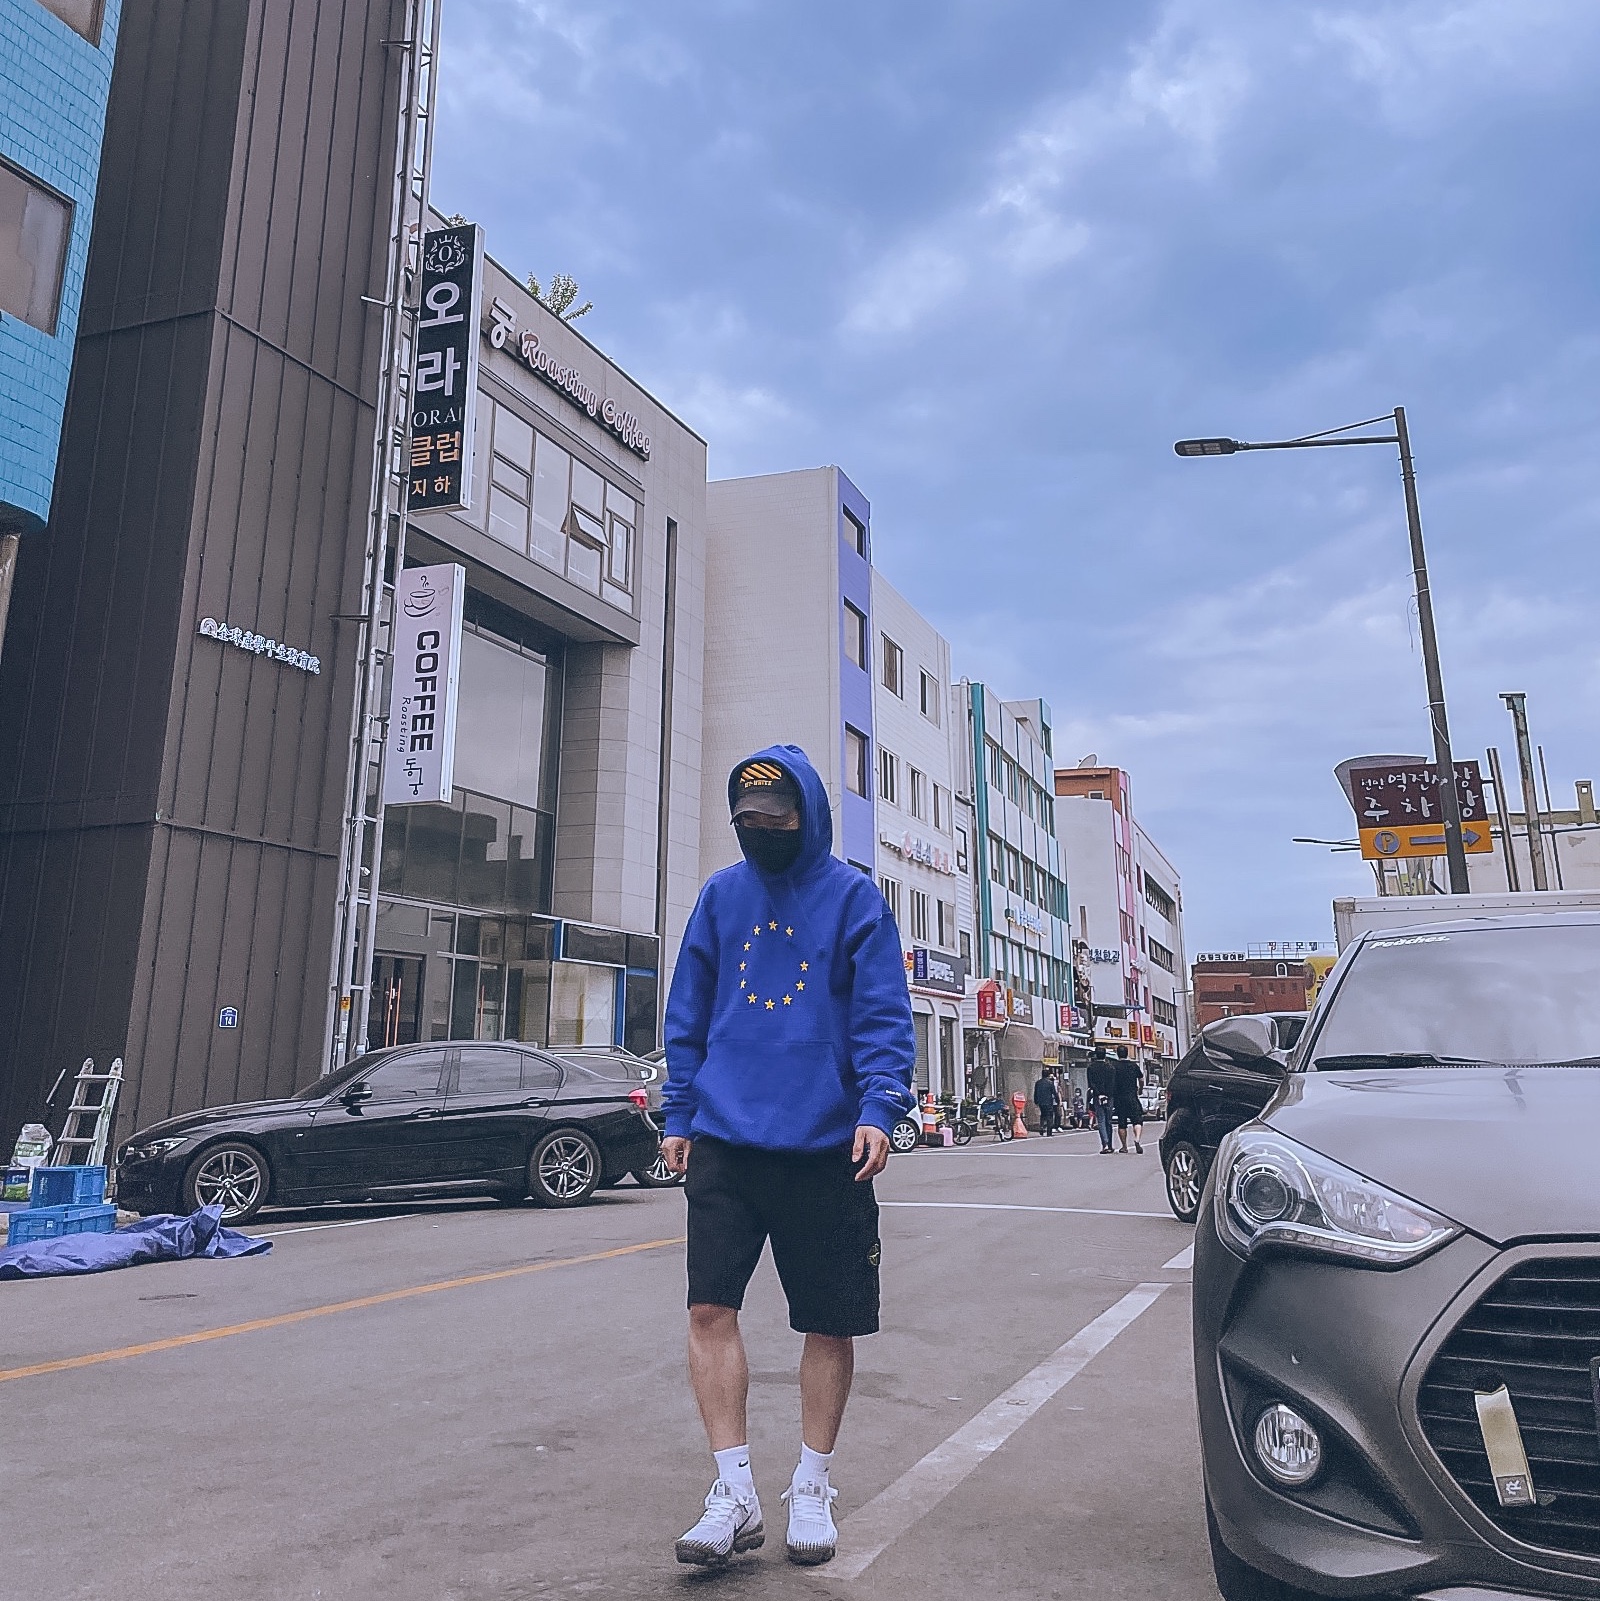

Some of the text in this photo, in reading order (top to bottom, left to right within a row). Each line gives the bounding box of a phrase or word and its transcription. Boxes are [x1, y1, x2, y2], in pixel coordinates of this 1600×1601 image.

[416, 281, 464, 397] 오라
[518, 329, 651, 454] Roasting Coffee
[410, 430, 462, 467] 클럽
[411, 475, 451, 497] 지하
[396, 696, 412, 753] Roasting
[409, 629, 440, 753] COFFEE
